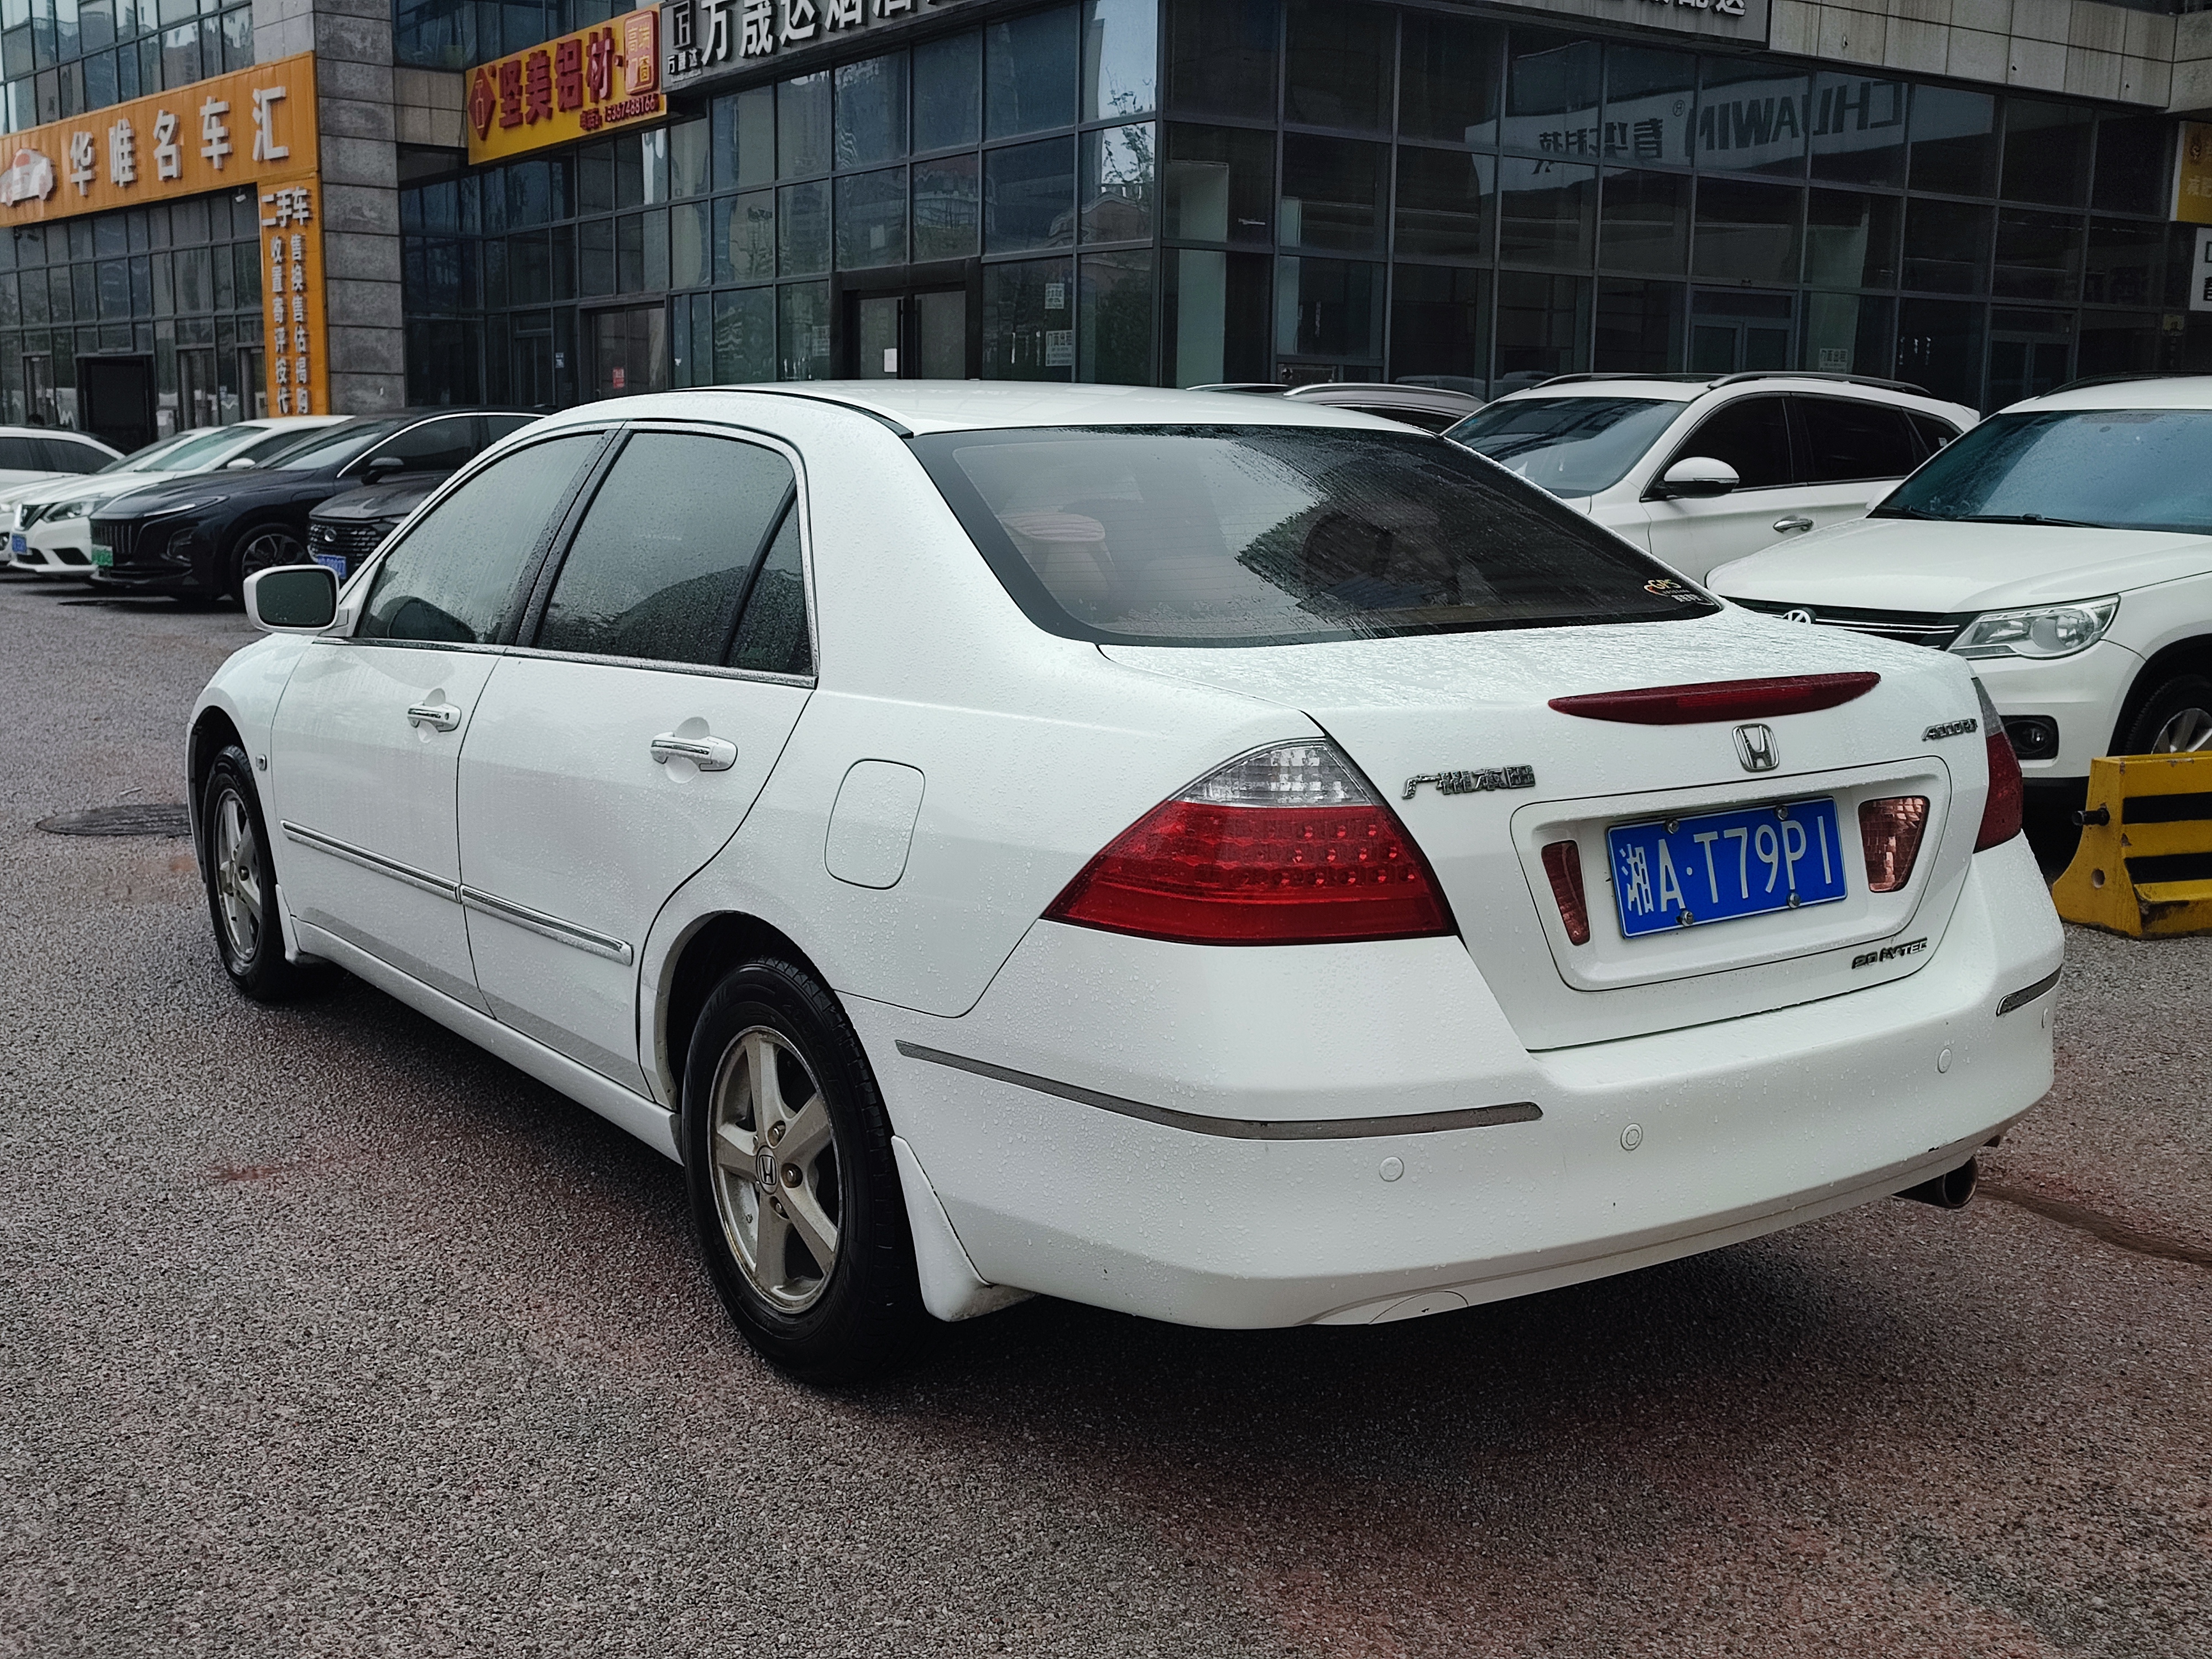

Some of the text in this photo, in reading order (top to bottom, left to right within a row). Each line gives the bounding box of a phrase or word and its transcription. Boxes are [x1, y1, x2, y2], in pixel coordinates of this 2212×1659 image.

[70, 86, 289, 196] 华唯名车汇
[262, 186, 309, 227] 二手车
[1401, 764, 1536, 800] 广州本田
